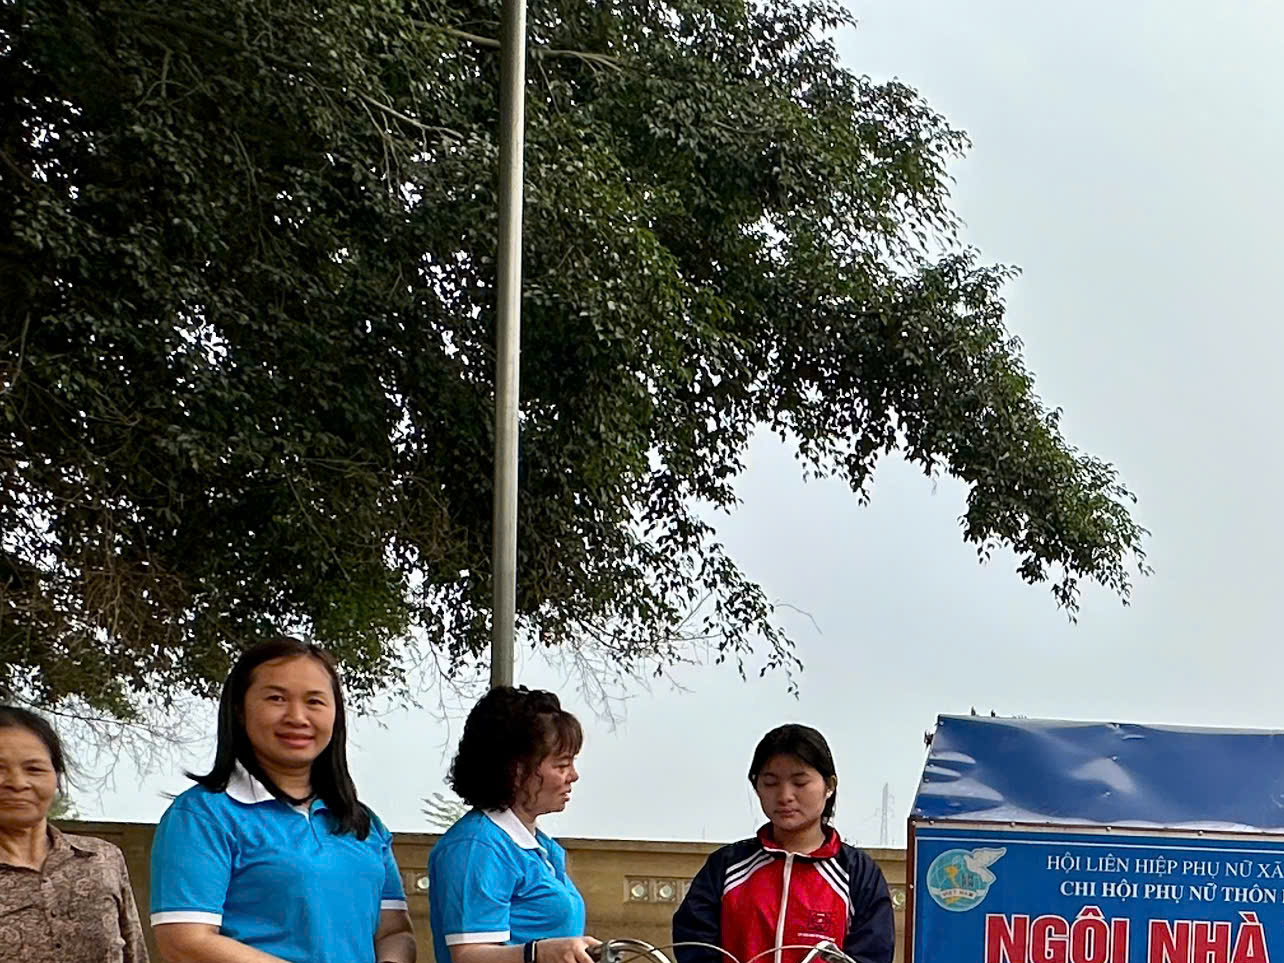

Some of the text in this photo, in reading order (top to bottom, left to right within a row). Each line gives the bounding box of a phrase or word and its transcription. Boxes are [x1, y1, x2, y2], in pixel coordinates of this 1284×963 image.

[1046, 852, 1080, 874] HỘI
[1086, 853, 1130, 872] LIÊN
[1135, 855, 1176, 876] HIỆP
[1182, 860, 1219, 878] PHỤ
[1225, 859, 1253, 877] NỮ
[1257, 861, 1284, 878] XÃ
[1060, 880, 1096, 897] CHI
[1102, 878, 1138, 902] HỘI
[1144, 884, 1183, 903] PHỤ
[1189, 883, 1218, 901] NỮ
[1221, 884, 1277, 903] THÔN
